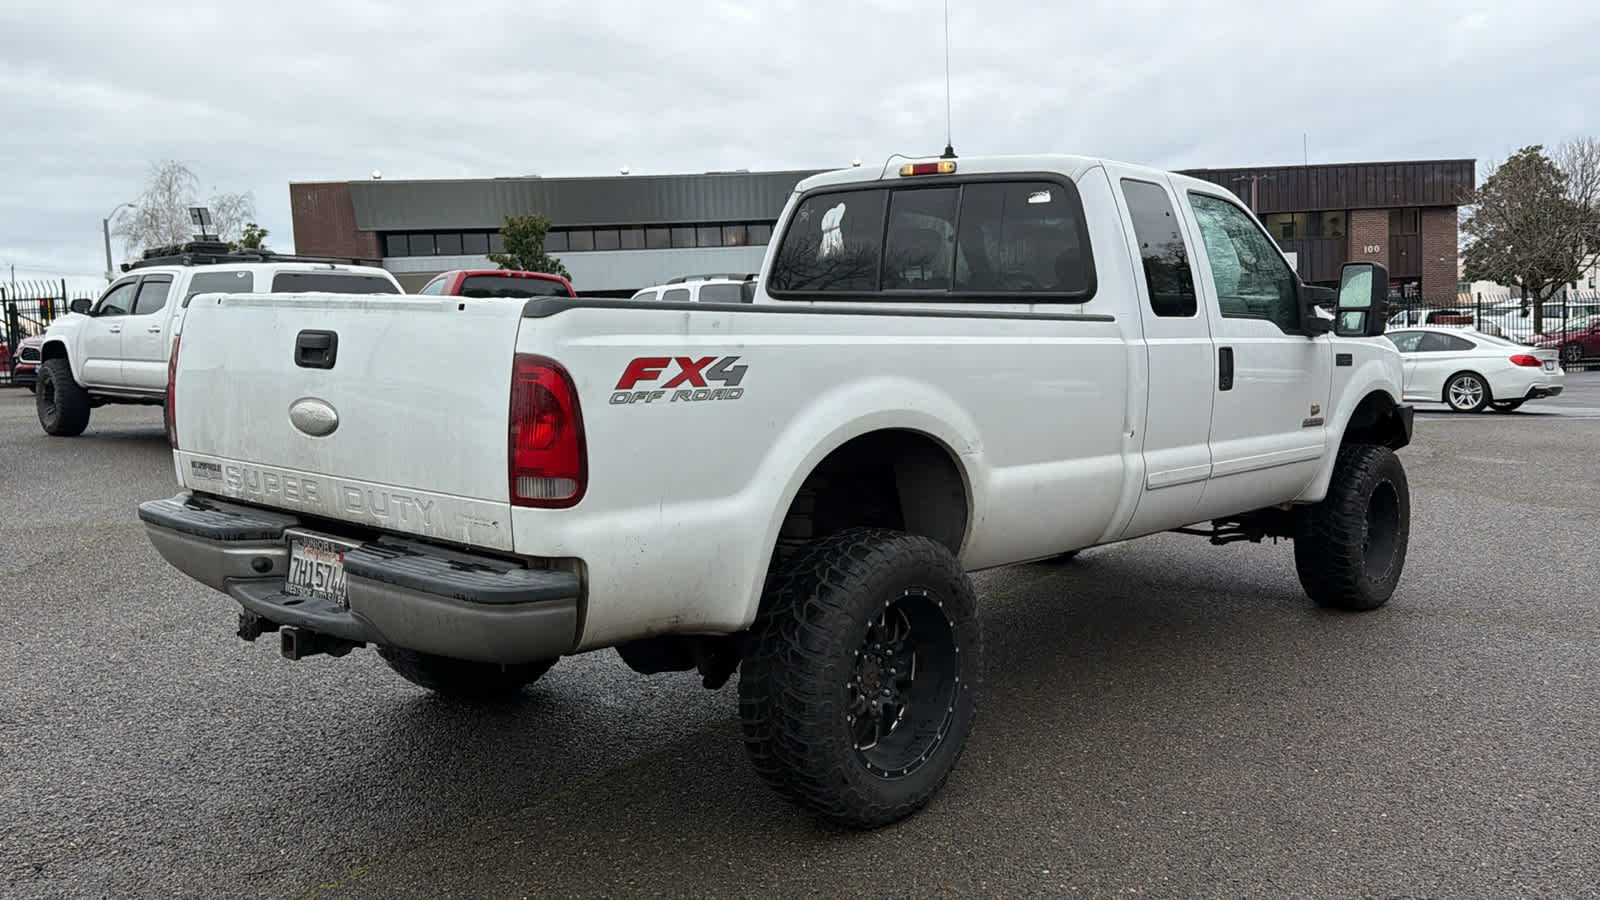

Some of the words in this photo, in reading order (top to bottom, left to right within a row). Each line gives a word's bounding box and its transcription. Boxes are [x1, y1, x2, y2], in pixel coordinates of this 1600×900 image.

[1364, 244, 1380, 254] 100
[614, 356, 749, 390] FX4
[609, 390, 666, 405] OFF
[670, 388, 744, 402] ROAD
[225, 465, 320, 504] SUPER
[343, 486, 434, 526] DUTY
[293, 557, 345, 594] 7H15744
